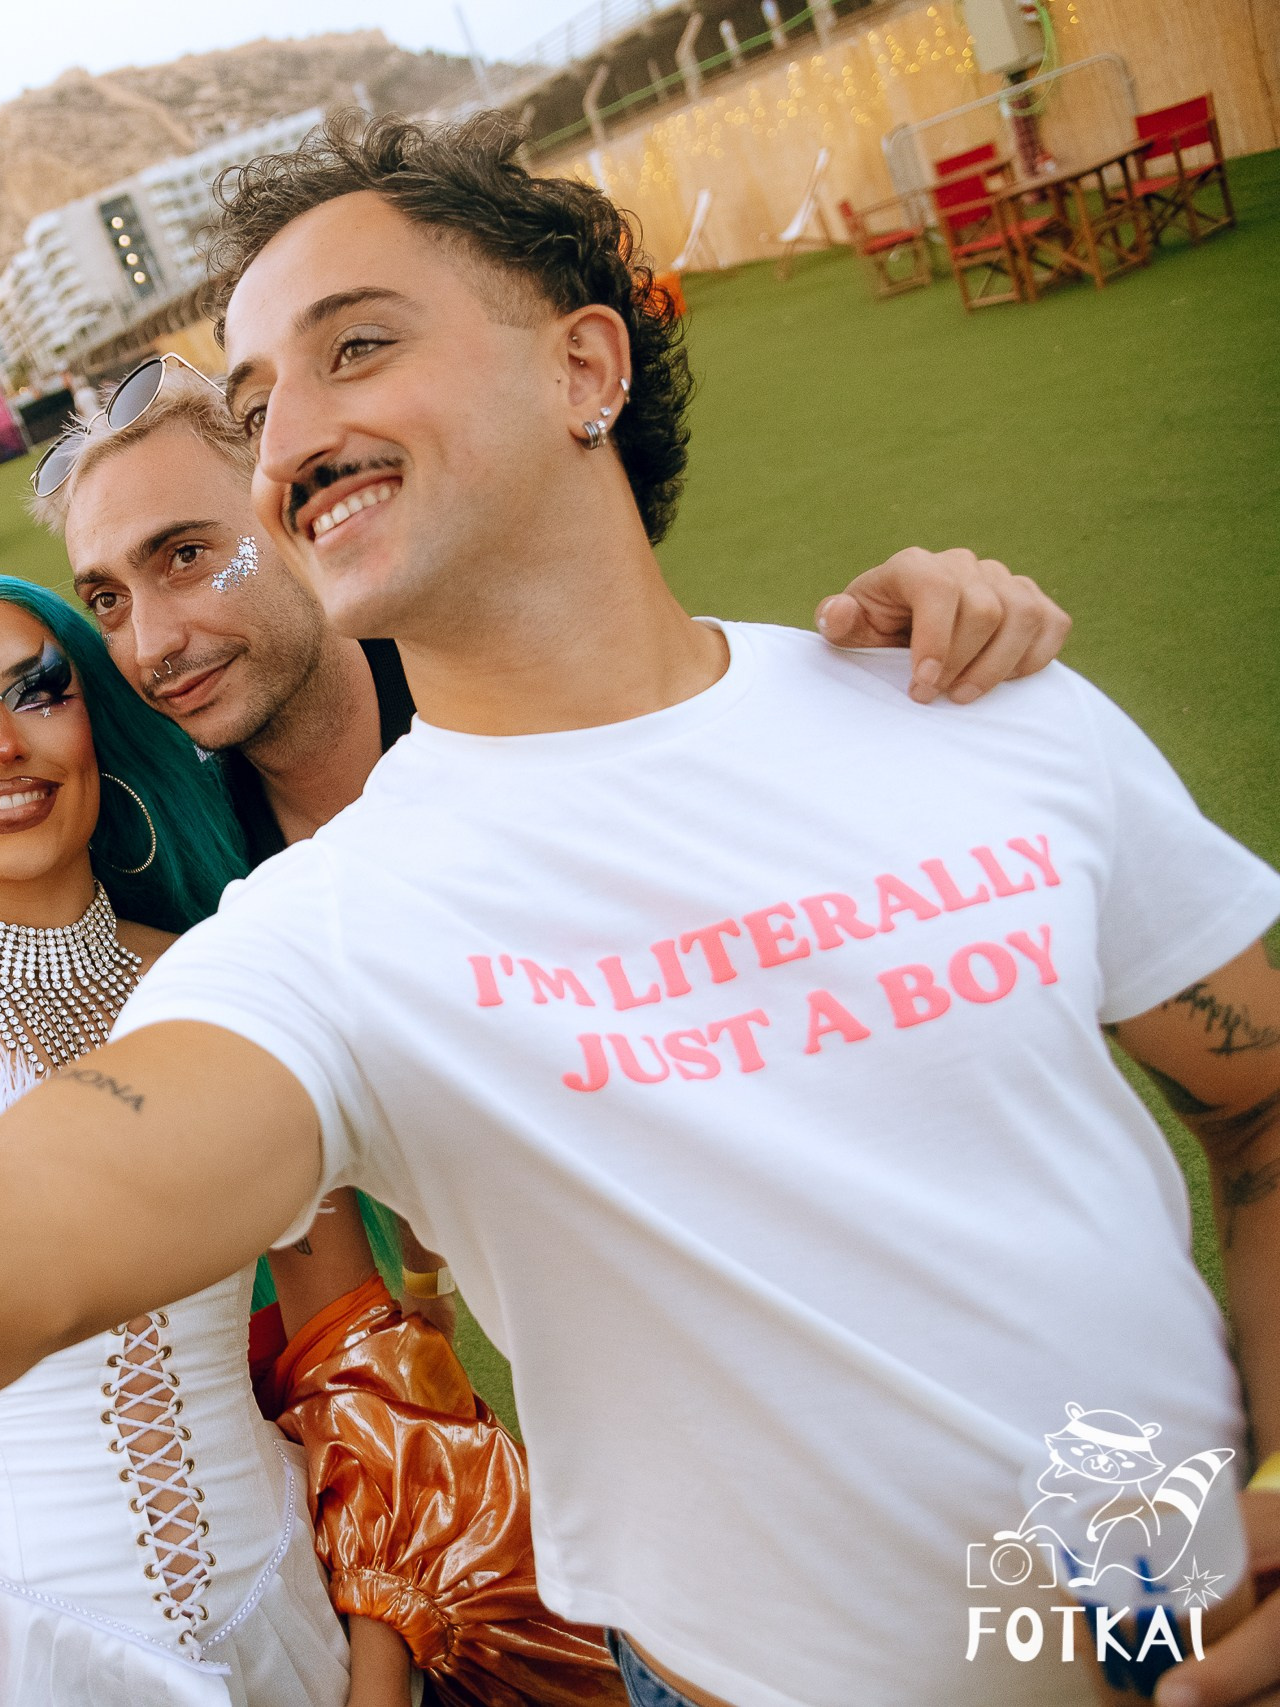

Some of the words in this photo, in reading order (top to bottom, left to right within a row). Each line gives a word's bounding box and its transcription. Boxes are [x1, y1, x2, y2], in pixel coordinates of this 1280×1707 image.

[468, 955, 595, 1007] I'M
[597, 834, 1060, 1010] LITERALLY
[561, 1008, 770, 1092] JUST
[803, 989, 871, 1055] A
[876, 924, 1059, 1030] BOY
